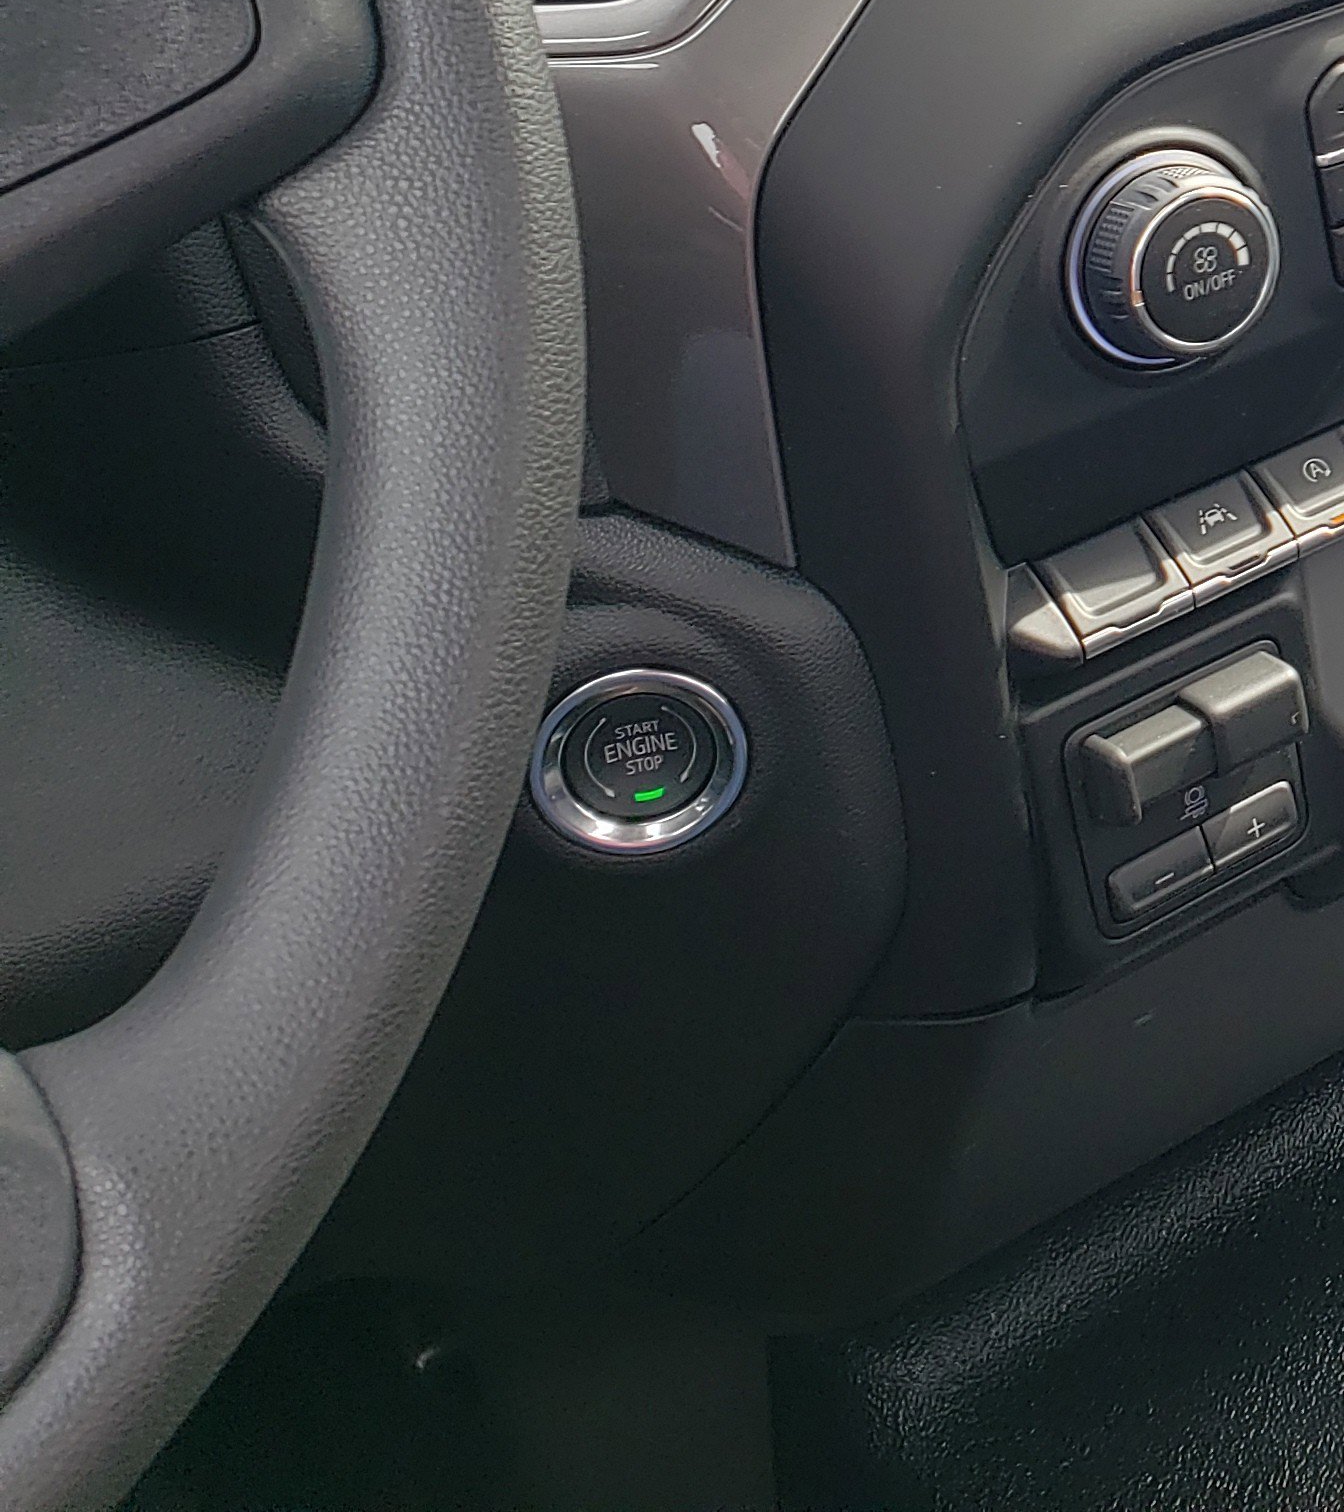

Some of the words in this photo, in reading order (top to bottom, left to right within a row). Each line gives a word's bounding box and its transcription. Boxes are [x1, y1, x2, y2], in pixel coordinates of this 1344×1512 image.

[1184, 268, 1236, 300] ON/OFF
[615, 720, 659, 740] START
[604, 732, 677, 764] ENGINE
[626, 755, 663, 776] STOP
